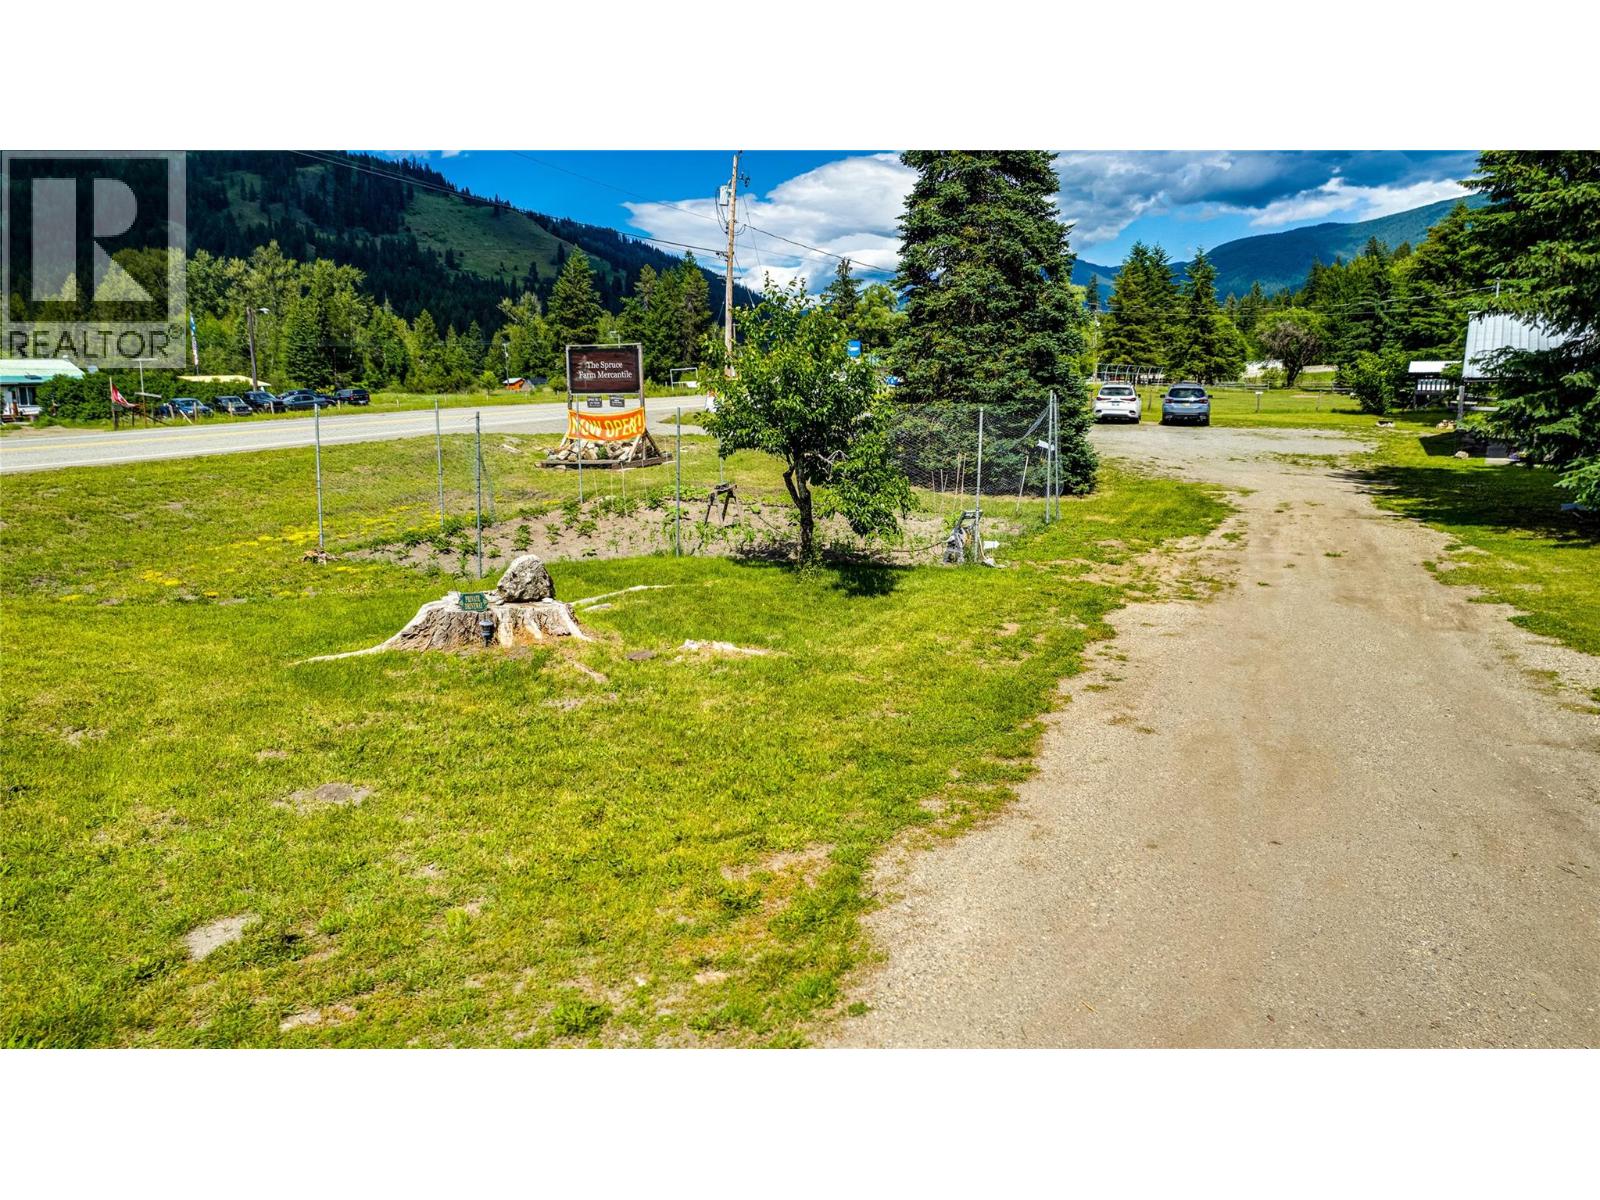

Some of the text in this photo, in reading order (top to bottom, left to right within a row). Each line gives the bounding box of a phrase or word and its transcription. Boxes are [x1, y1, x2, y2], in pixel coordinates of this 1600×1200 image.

[586, 361, 623, 371] The Spruce
[578, 370, 633, 379] Farm Mercantile
[571, 414, 642, 438] NOW OPEN!
